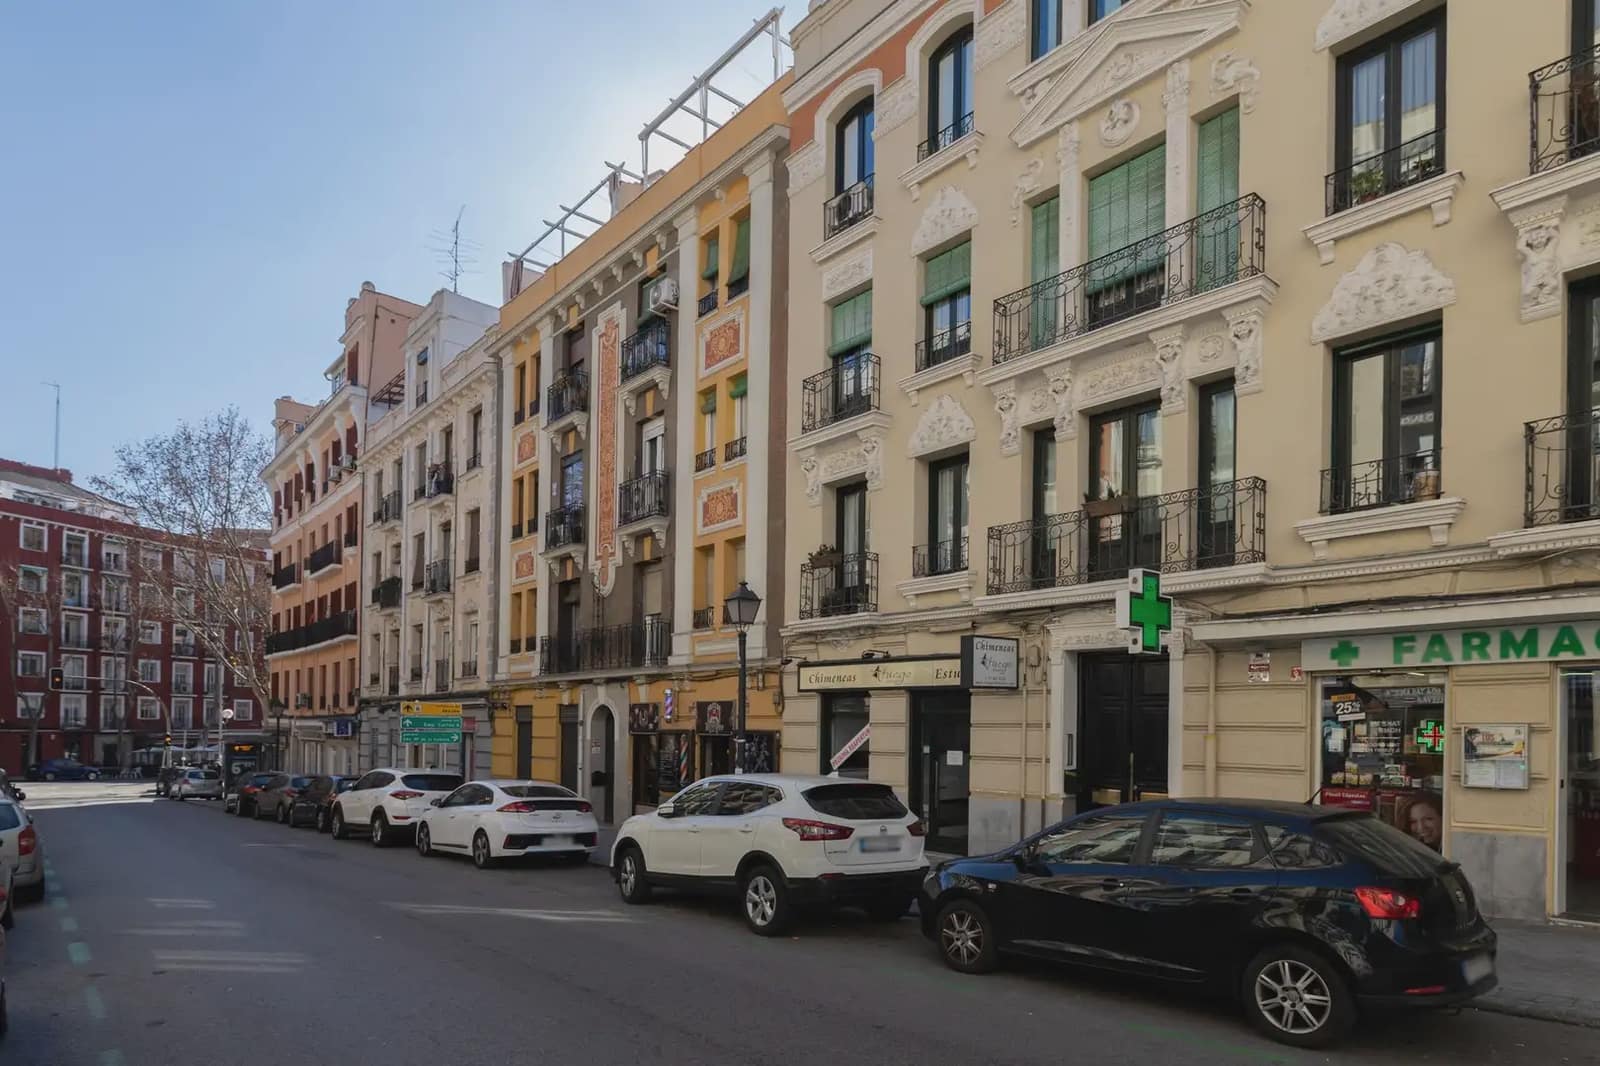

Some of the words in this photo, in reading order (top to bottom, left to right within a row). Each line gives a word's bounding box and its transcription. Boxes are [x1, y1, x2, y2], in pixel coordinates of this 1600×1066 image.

[976, 640, 1014, 652] Chimeneas
[1393, 625, 1600, 665] FARMA
[808, 671, 857, 684] Chimeneas
